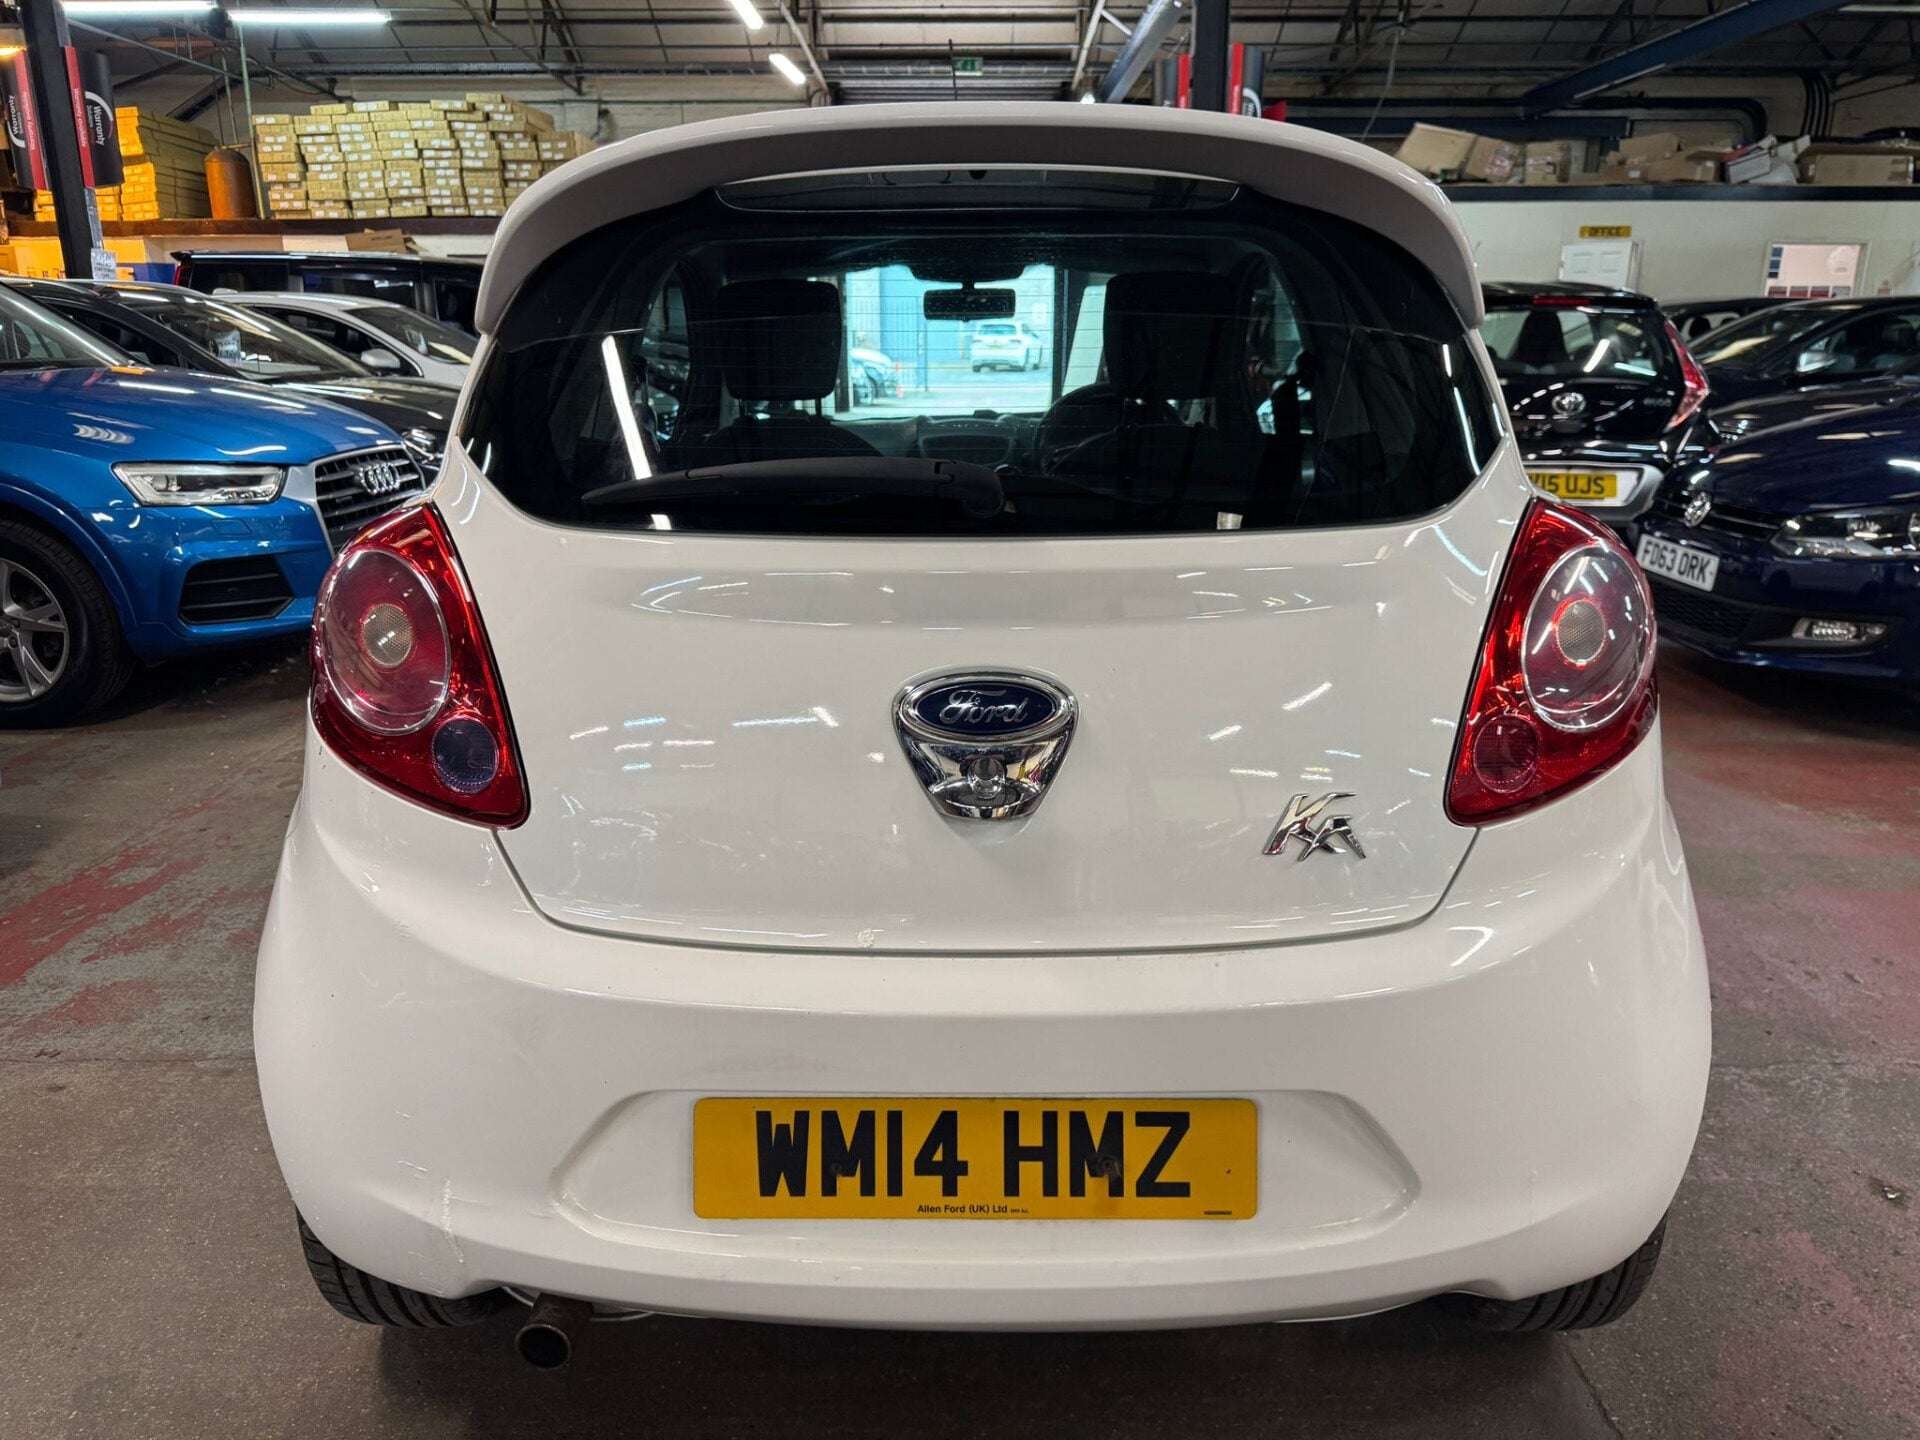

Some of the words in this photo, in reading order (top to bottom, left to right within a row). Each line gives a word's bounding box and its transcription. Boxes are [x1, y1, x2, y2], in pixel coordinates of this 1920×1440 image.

[93, 106, 105, 146] Warranty
[1566, 474, 1605, 495] UJS
[939, 689, 1029, 724] Ford
[755, 1110, 968, 1197] WM14
[1003, 1110, 1190, 1197] HMZ
[917, 1204, 941, 1214] Allen
[944, 1204, 966, 1214] Ford
[969, 1204, 990, 1214] (UK)
[992, 1204, 1008, 1214] Ltd
